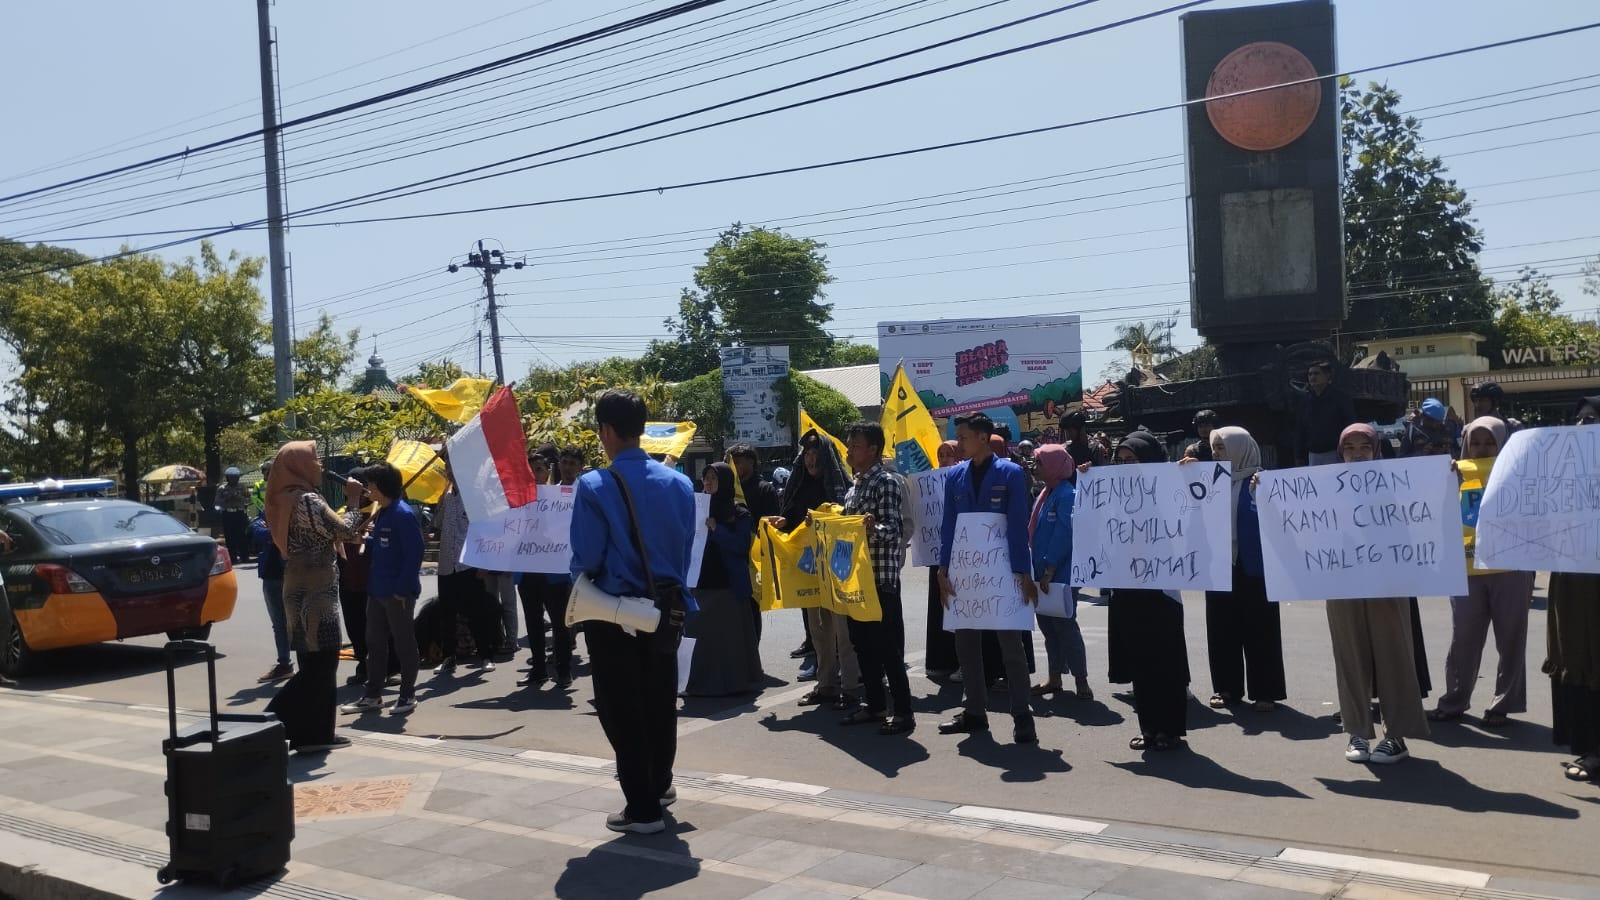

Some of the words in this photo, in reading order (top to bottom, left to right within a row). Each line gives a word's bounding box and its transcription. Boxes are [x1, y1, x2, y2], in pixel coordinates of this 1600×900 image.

[956, 339, 1009, 364] BLORA
[1502, 344, 1580, 364] WATER
[1268, 473, 1318, 503] ANDA
[1335, 469, 1411, 494] SOPAN
[503, 517, 540, 535] KITA
[1107, 517, 1184, 545] PEMILU
[1282, 508, 1339, 534] KAMI
[1352, 501, 1433, 528] CURIGA
[475, 538, 505, 556] TETAP
[1304, 543, 1383, 572] NYALEG
[1130, 550, 1201, 583] DAMAI
